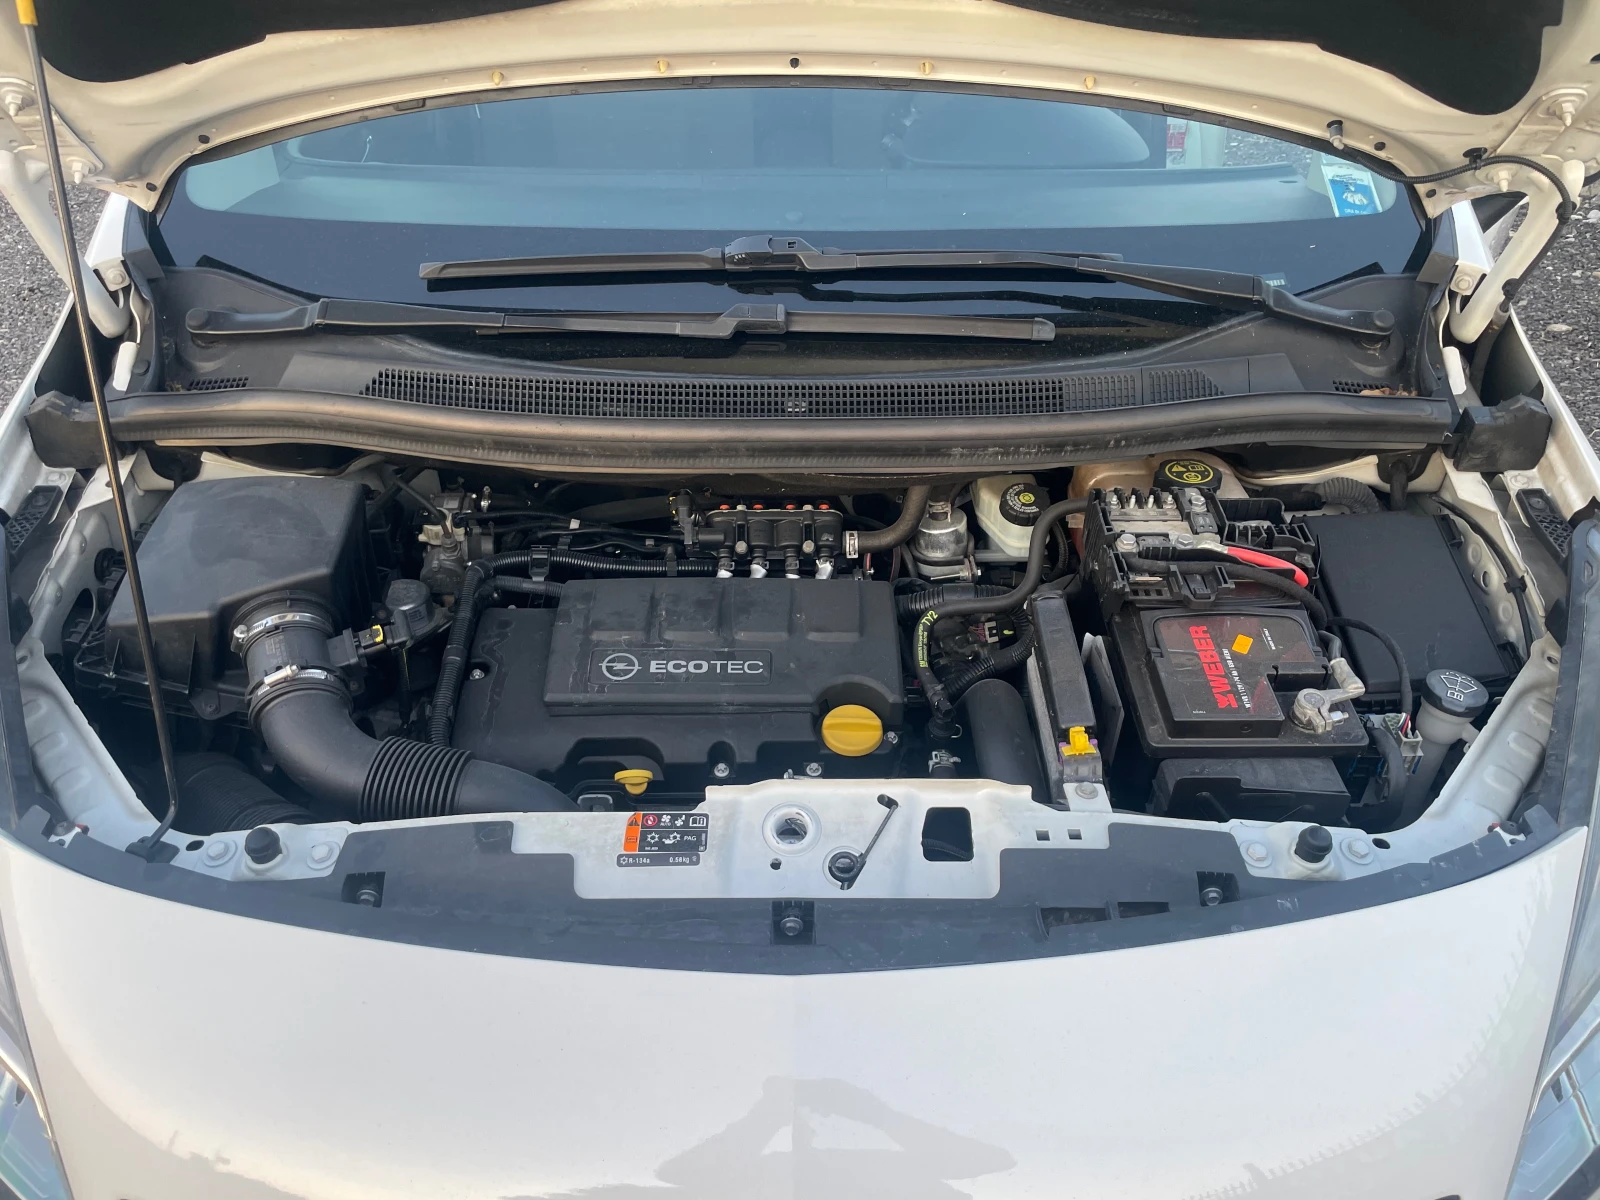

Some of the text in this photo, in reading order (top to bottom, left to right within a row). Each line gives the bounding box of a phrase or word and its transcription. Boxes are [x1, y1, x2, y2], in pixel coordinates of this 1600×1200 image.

[921, 610, 938, 626] TY2
[650, 660, 764, 674] ECOTEC
[1189, 625, 1232, 693] WEBER
